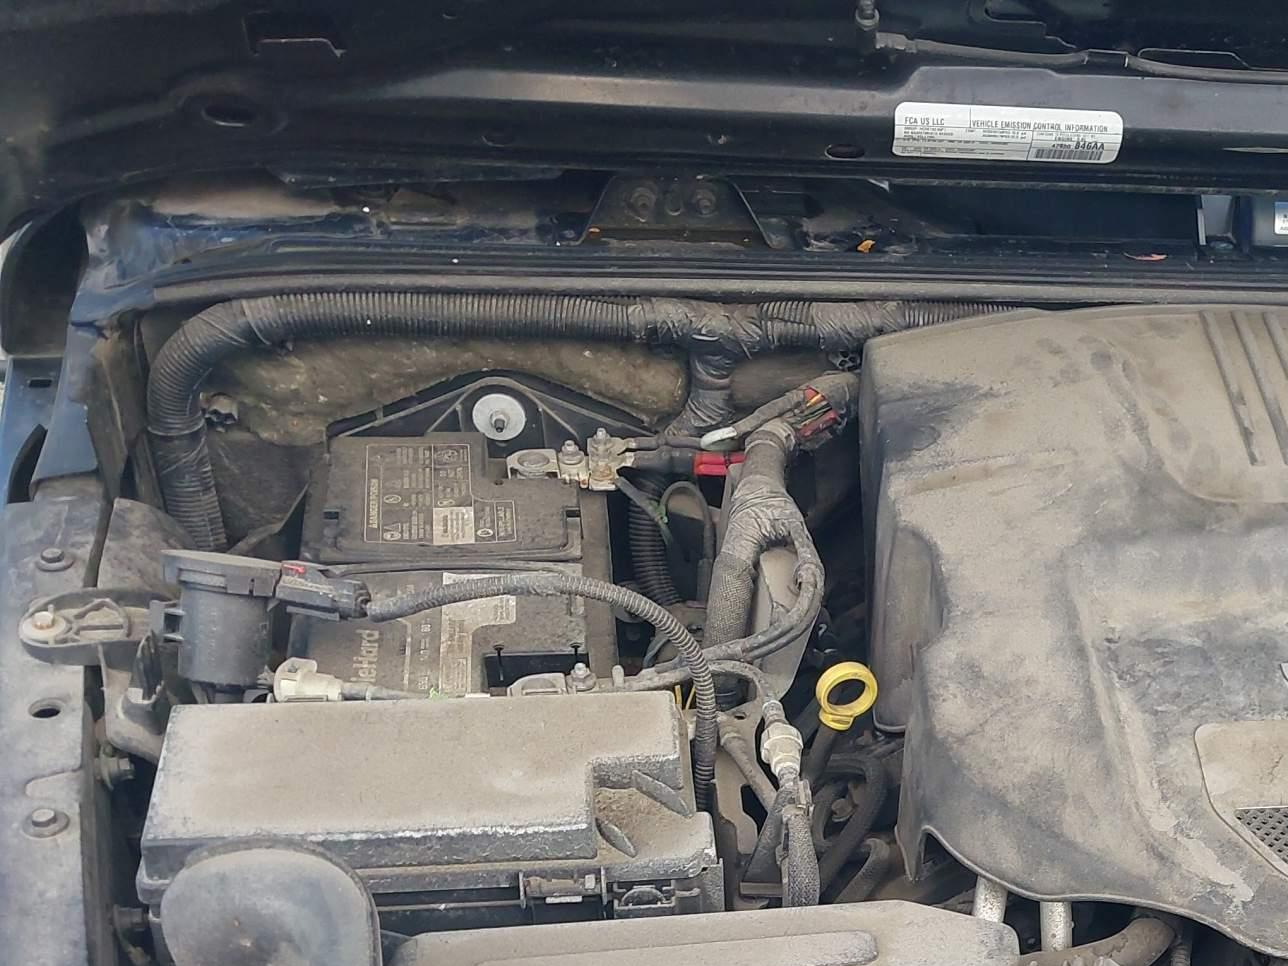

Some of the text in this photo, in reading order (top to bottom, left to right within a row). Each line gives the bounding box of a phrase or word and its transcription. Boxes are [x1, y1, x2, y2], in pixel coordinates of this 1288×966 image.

[904, 116, 945, 126] FCA US LLC
[972, 119, 1108, 132] VEHICLE EMISSION CONTROL INFORMATION
